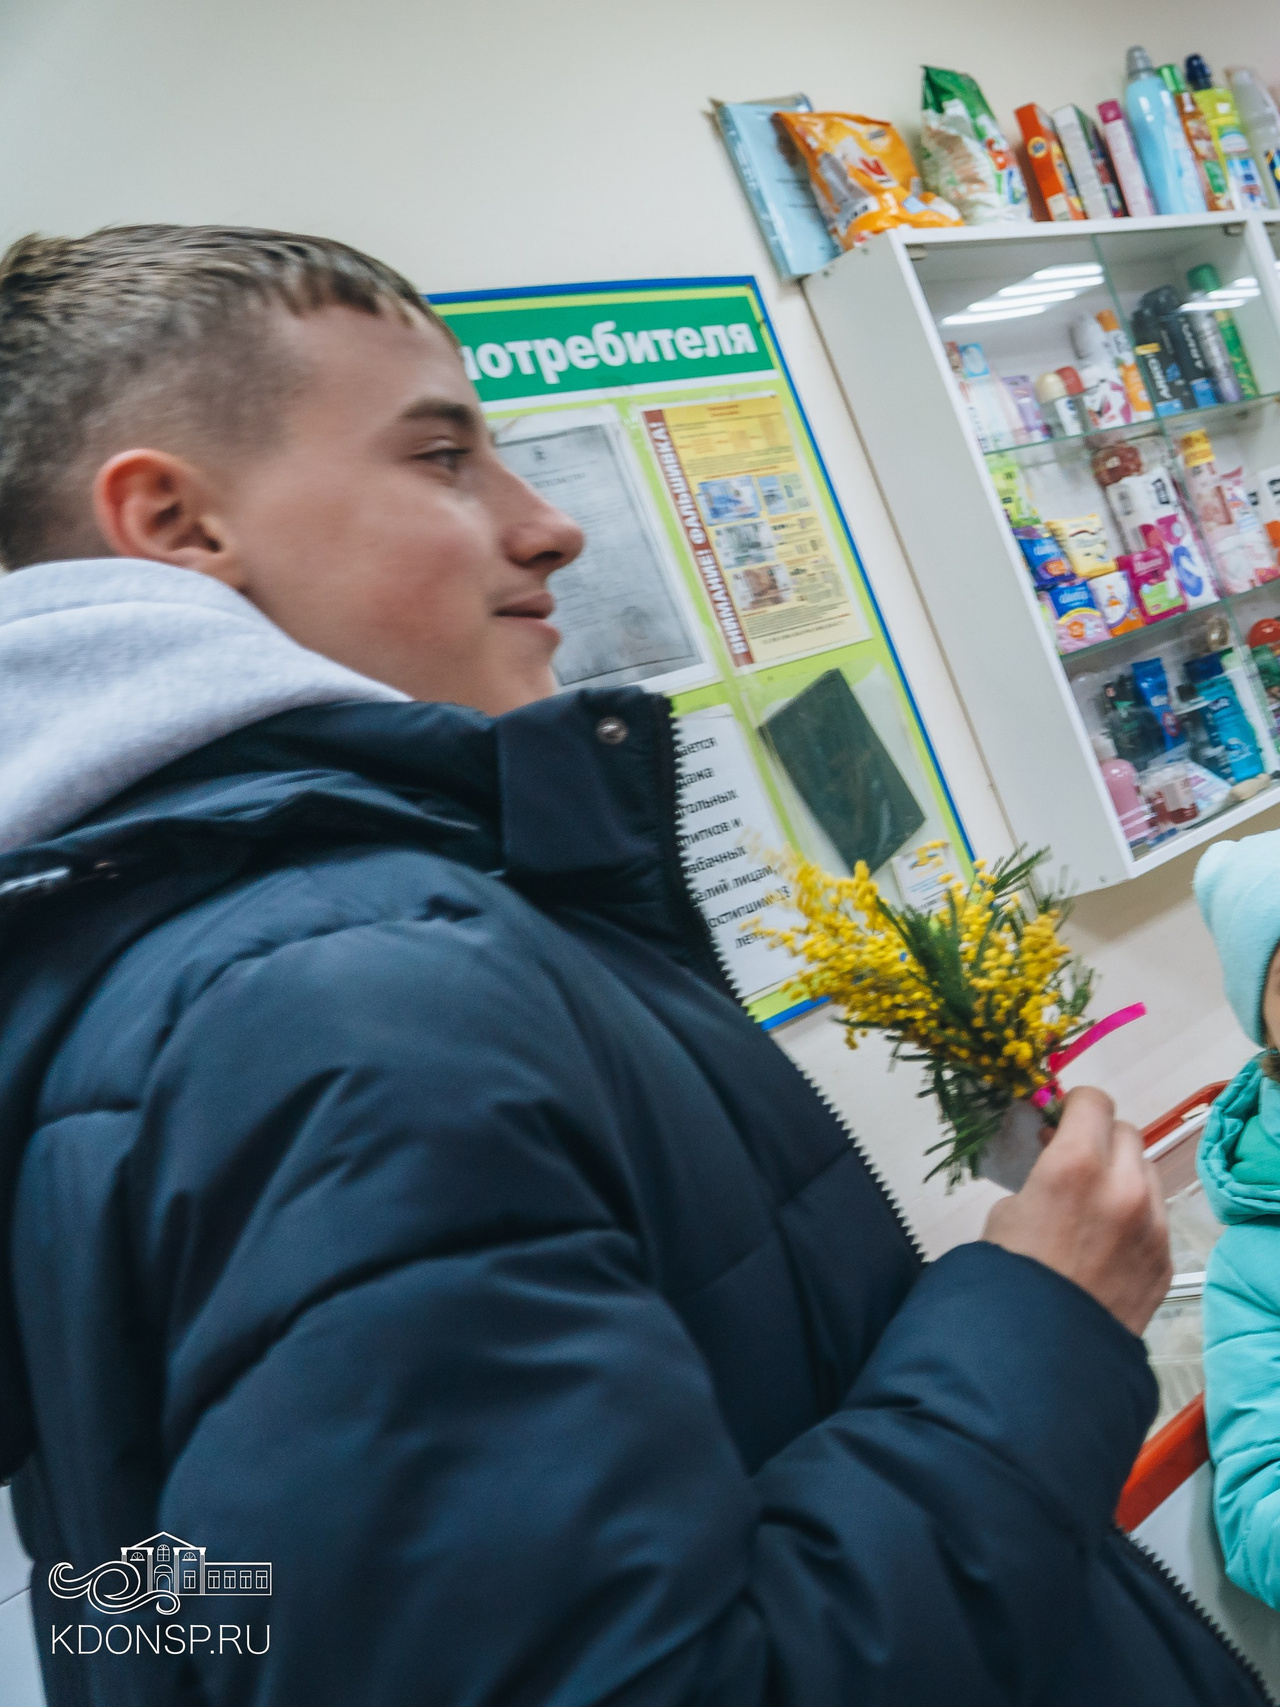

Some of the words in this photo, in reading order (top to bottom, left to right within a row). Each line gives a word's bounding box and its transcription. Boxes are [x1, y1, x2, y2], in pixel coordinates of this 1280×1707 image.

[648, 421, 707, 545] ФАЛЬШИВКА!
[696, 550, 749, 655] ВНИМАНИЕ!
[679, 737, 717, 757] ается
[679, 767, 714, 790] дажа
[679, 789, 738, 818] гольных
[680, 822, 730, 847] питков
[686, 845, 747, 875] абачных
